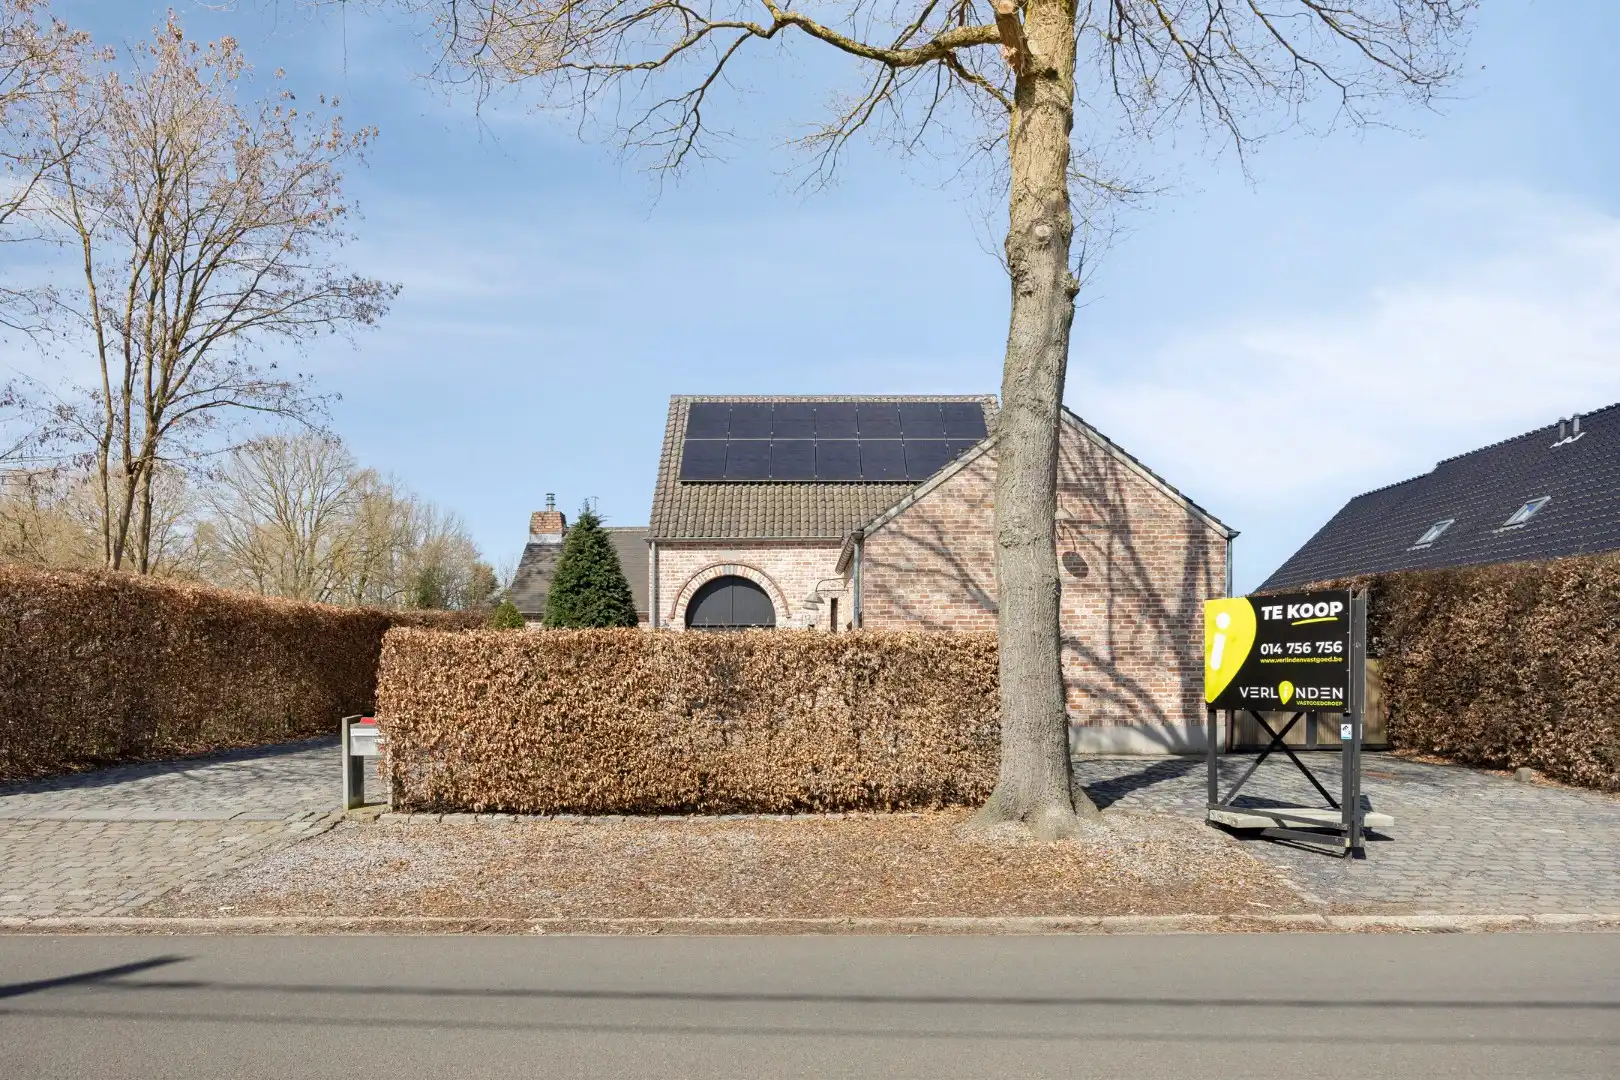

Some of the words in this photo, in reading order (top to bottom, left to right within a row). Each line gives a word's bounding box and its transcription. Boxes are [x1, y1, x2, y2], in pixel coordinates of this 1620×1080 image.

[1261, 605, 1283, 620] TE
[1287, 601, 1343, 619] KOOP
[1260, 643, 1283, 655] 014
[1286, 642, 1311, 654] 756
[1316, 641, 1342, 653] 756
[1260, 656, 1343, 664] www.verlindenvastgoed.be
